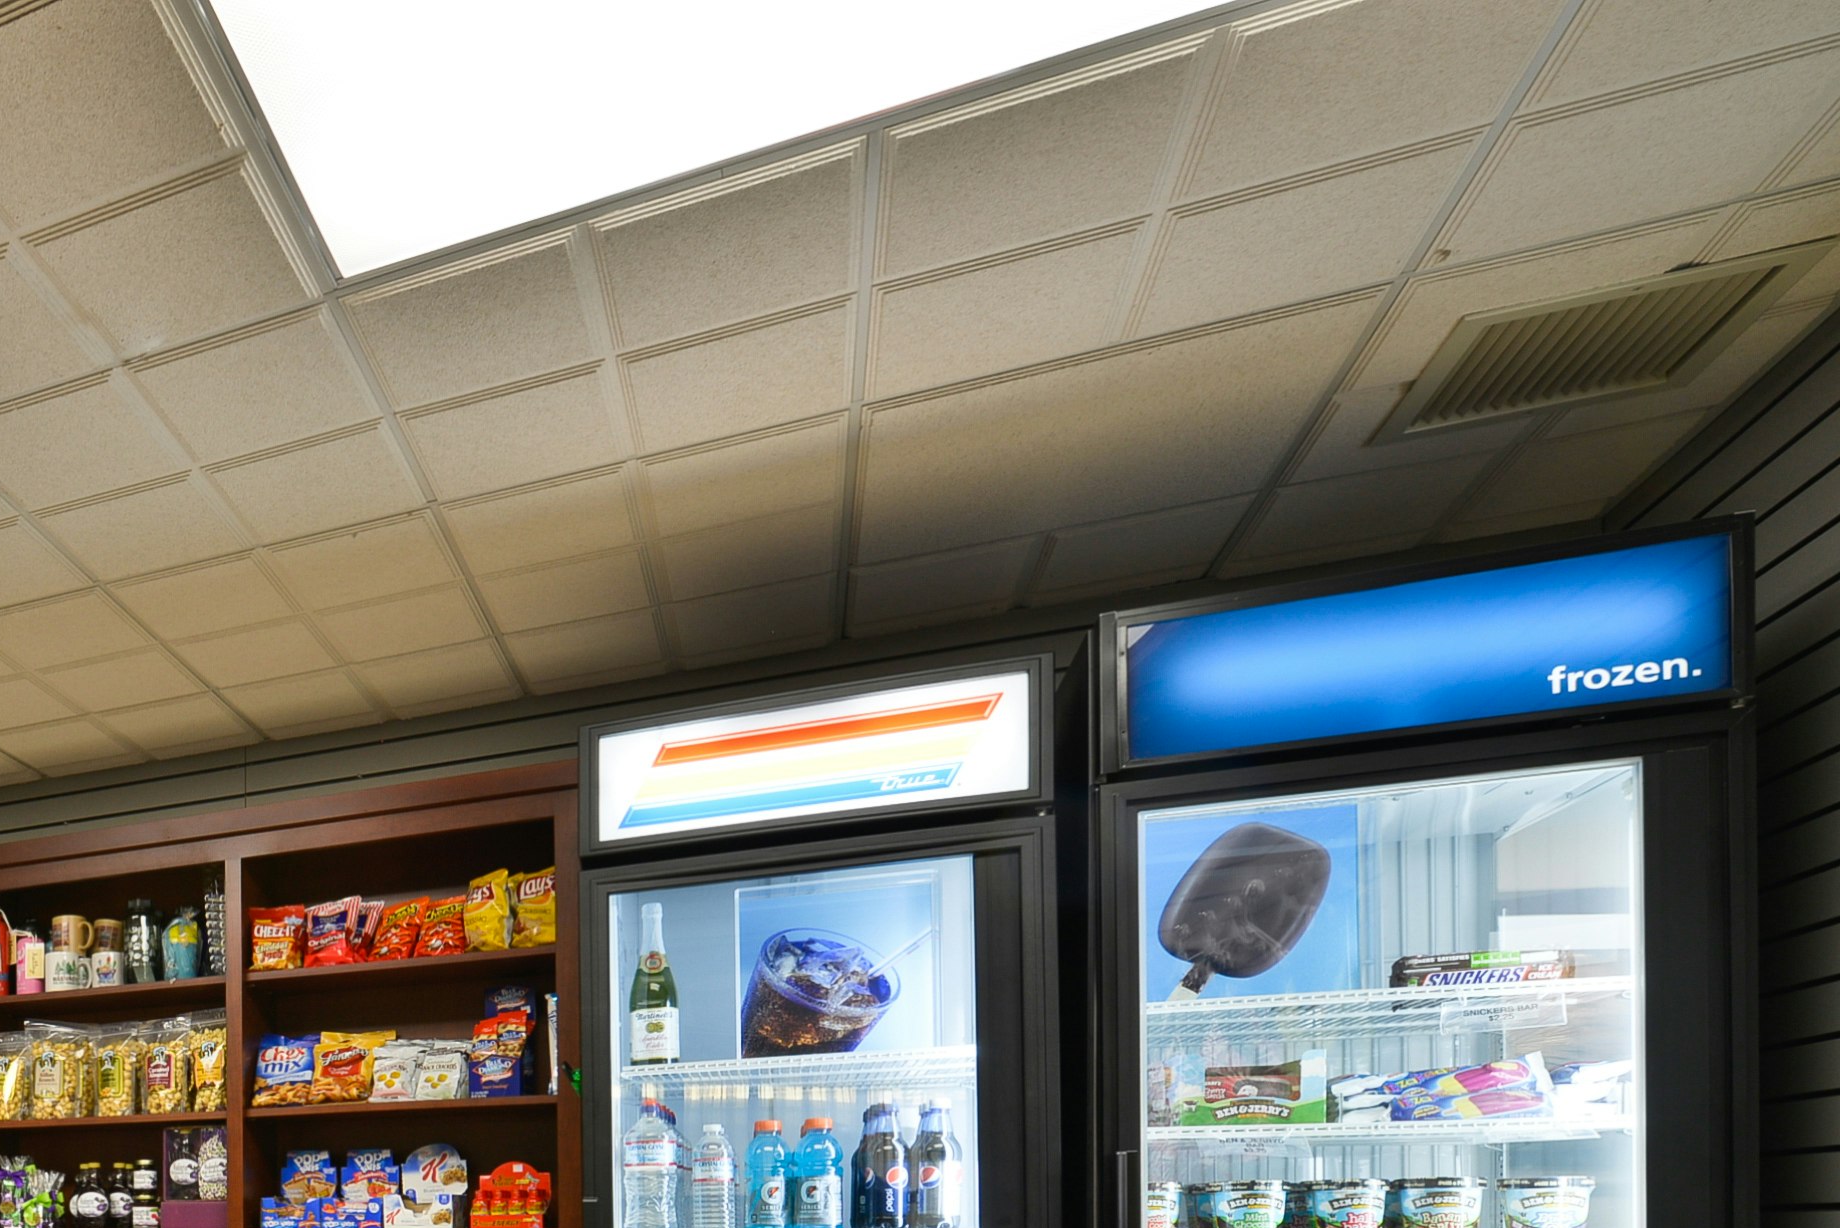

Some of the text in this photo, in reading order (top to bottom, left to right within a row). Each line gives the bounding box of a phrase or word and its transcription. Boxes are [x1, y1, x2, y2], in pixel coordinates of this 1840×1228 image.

[1547, 652, 1702, 695] frozen.
[870, 772, 945, 791] true
[308, 932, 346, 947] Original
[1427, 967, 1525, 987] SNICKERS
[261, 1046, 305, 1063] Chex
[421, 1152, 448, 1183] K
[885, 1188, 895, 1212] pepsi
[385, 1209, 401, 1225] K
[1244, 1212, 1269, 1221] Mint
[1422, 1212, 1469, 1223] Banana
